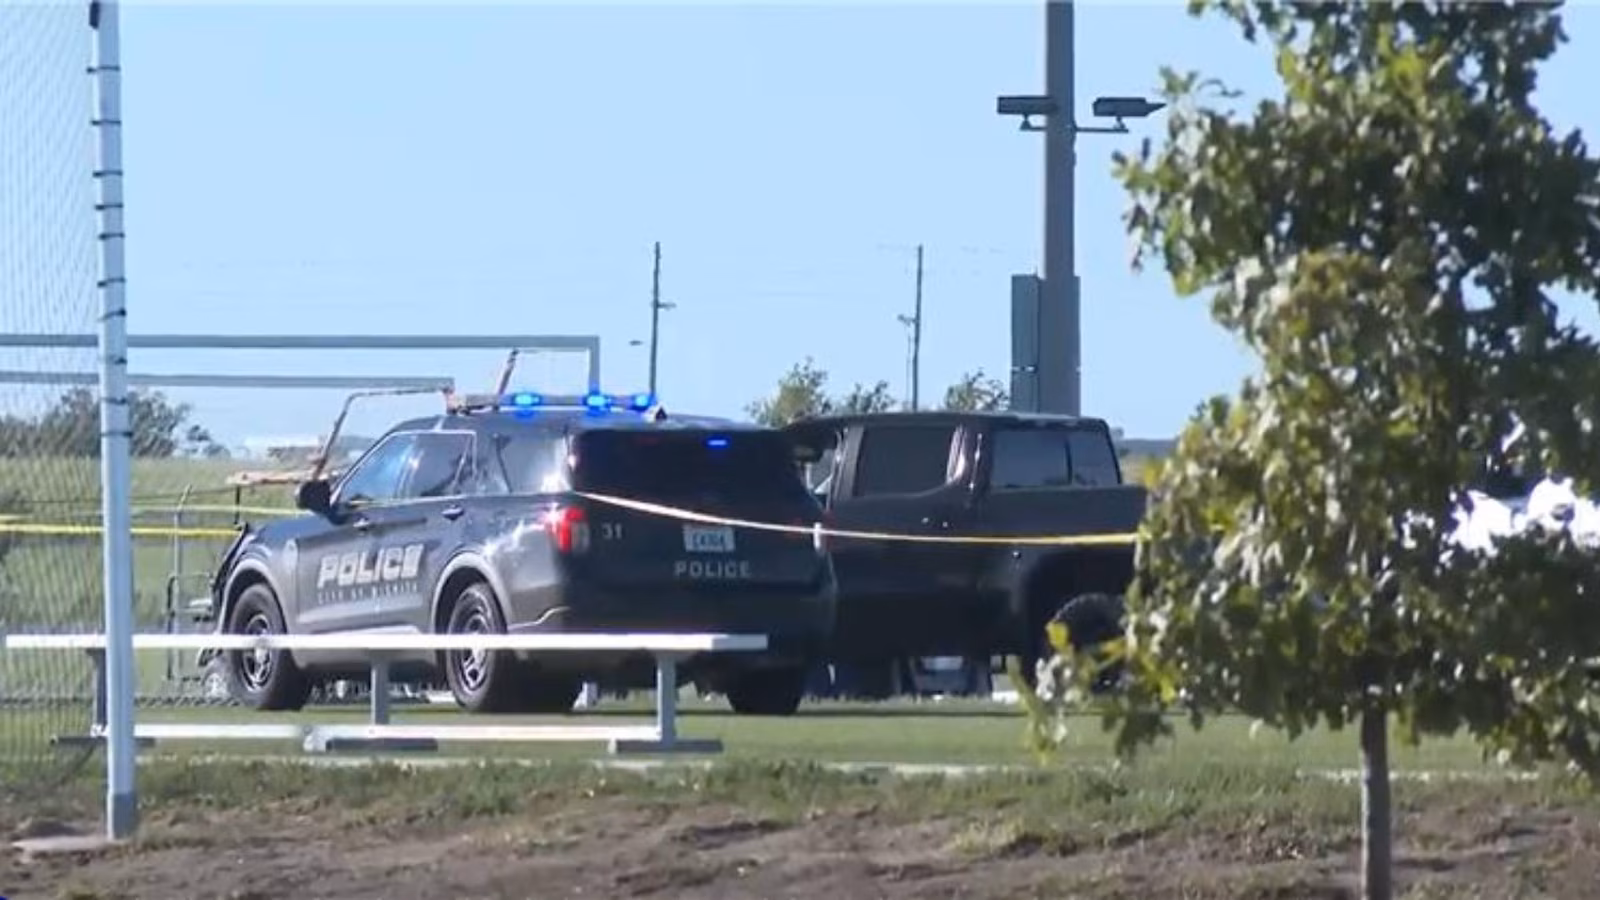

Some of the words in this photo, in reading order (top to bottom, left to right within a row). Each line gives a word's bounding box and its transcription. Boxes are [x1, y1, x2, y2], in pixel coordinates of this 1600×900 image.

[602, 522, 622, 539] 31
[317, 543, 424, 589] POLICE
[674, 560, 752, 578] POLICE
